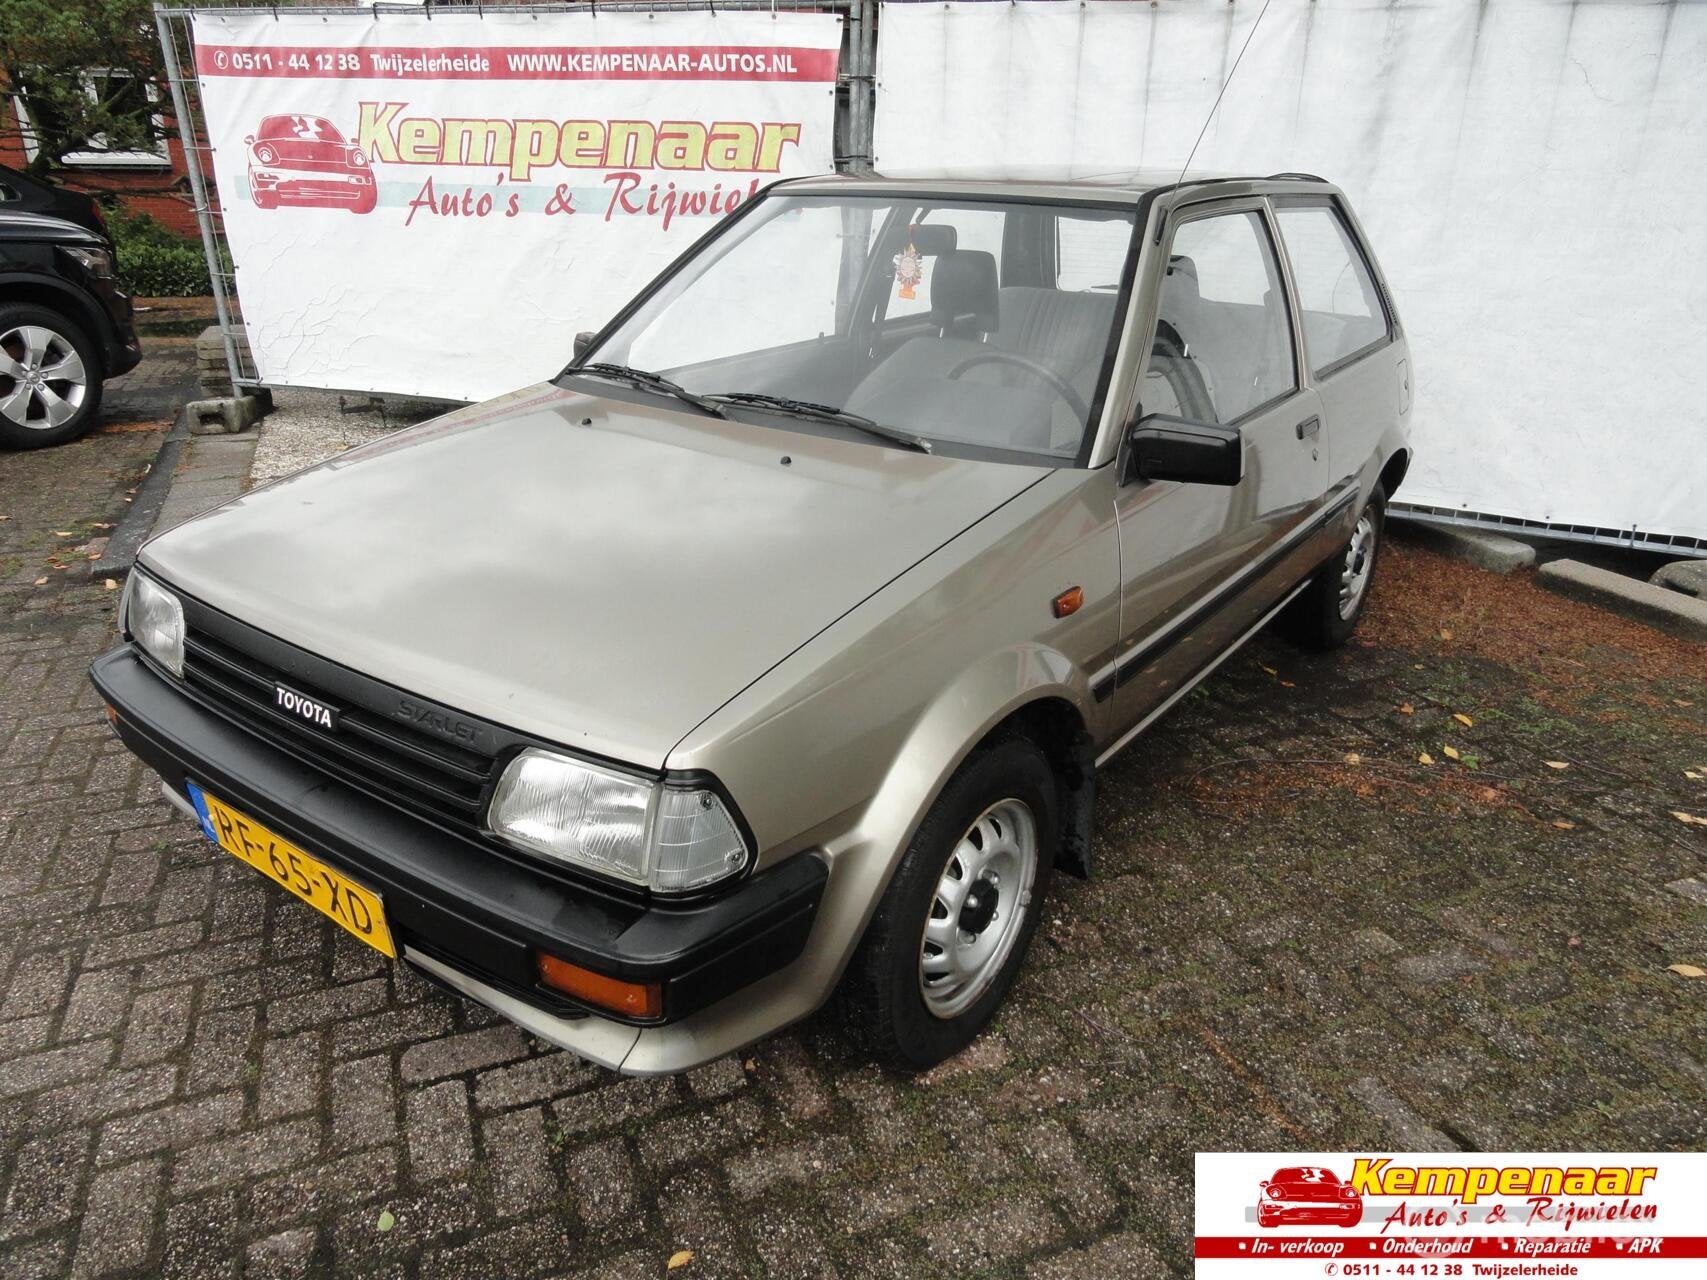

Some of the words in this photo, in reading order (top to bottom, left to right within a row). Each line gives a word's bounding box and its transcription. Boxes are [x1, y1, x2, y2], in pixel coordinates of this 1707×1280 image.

[233, 53, 273, 70] 0511
[288, 53, 310, 71] 44
[315, 54, 333, 71] 12
[338, 54, 360, 71] 38
[370, 54, 490, 76] Twijzelerheide
[507, 53, 798, 74] WWW.KEMPENAAR-AUTOS.NL
[358, 101, 801, 182] Kempenaar
[405, 172, 520, 227] Auto's
[544, 183, 577, 216] &
[603, 171, 761, 232] Rijwiel
[276, 686, 332, 728] TOYOTA
[399, 700, 483, 741] STARLET
[213, 805, 373, 935] RF-65-XD
